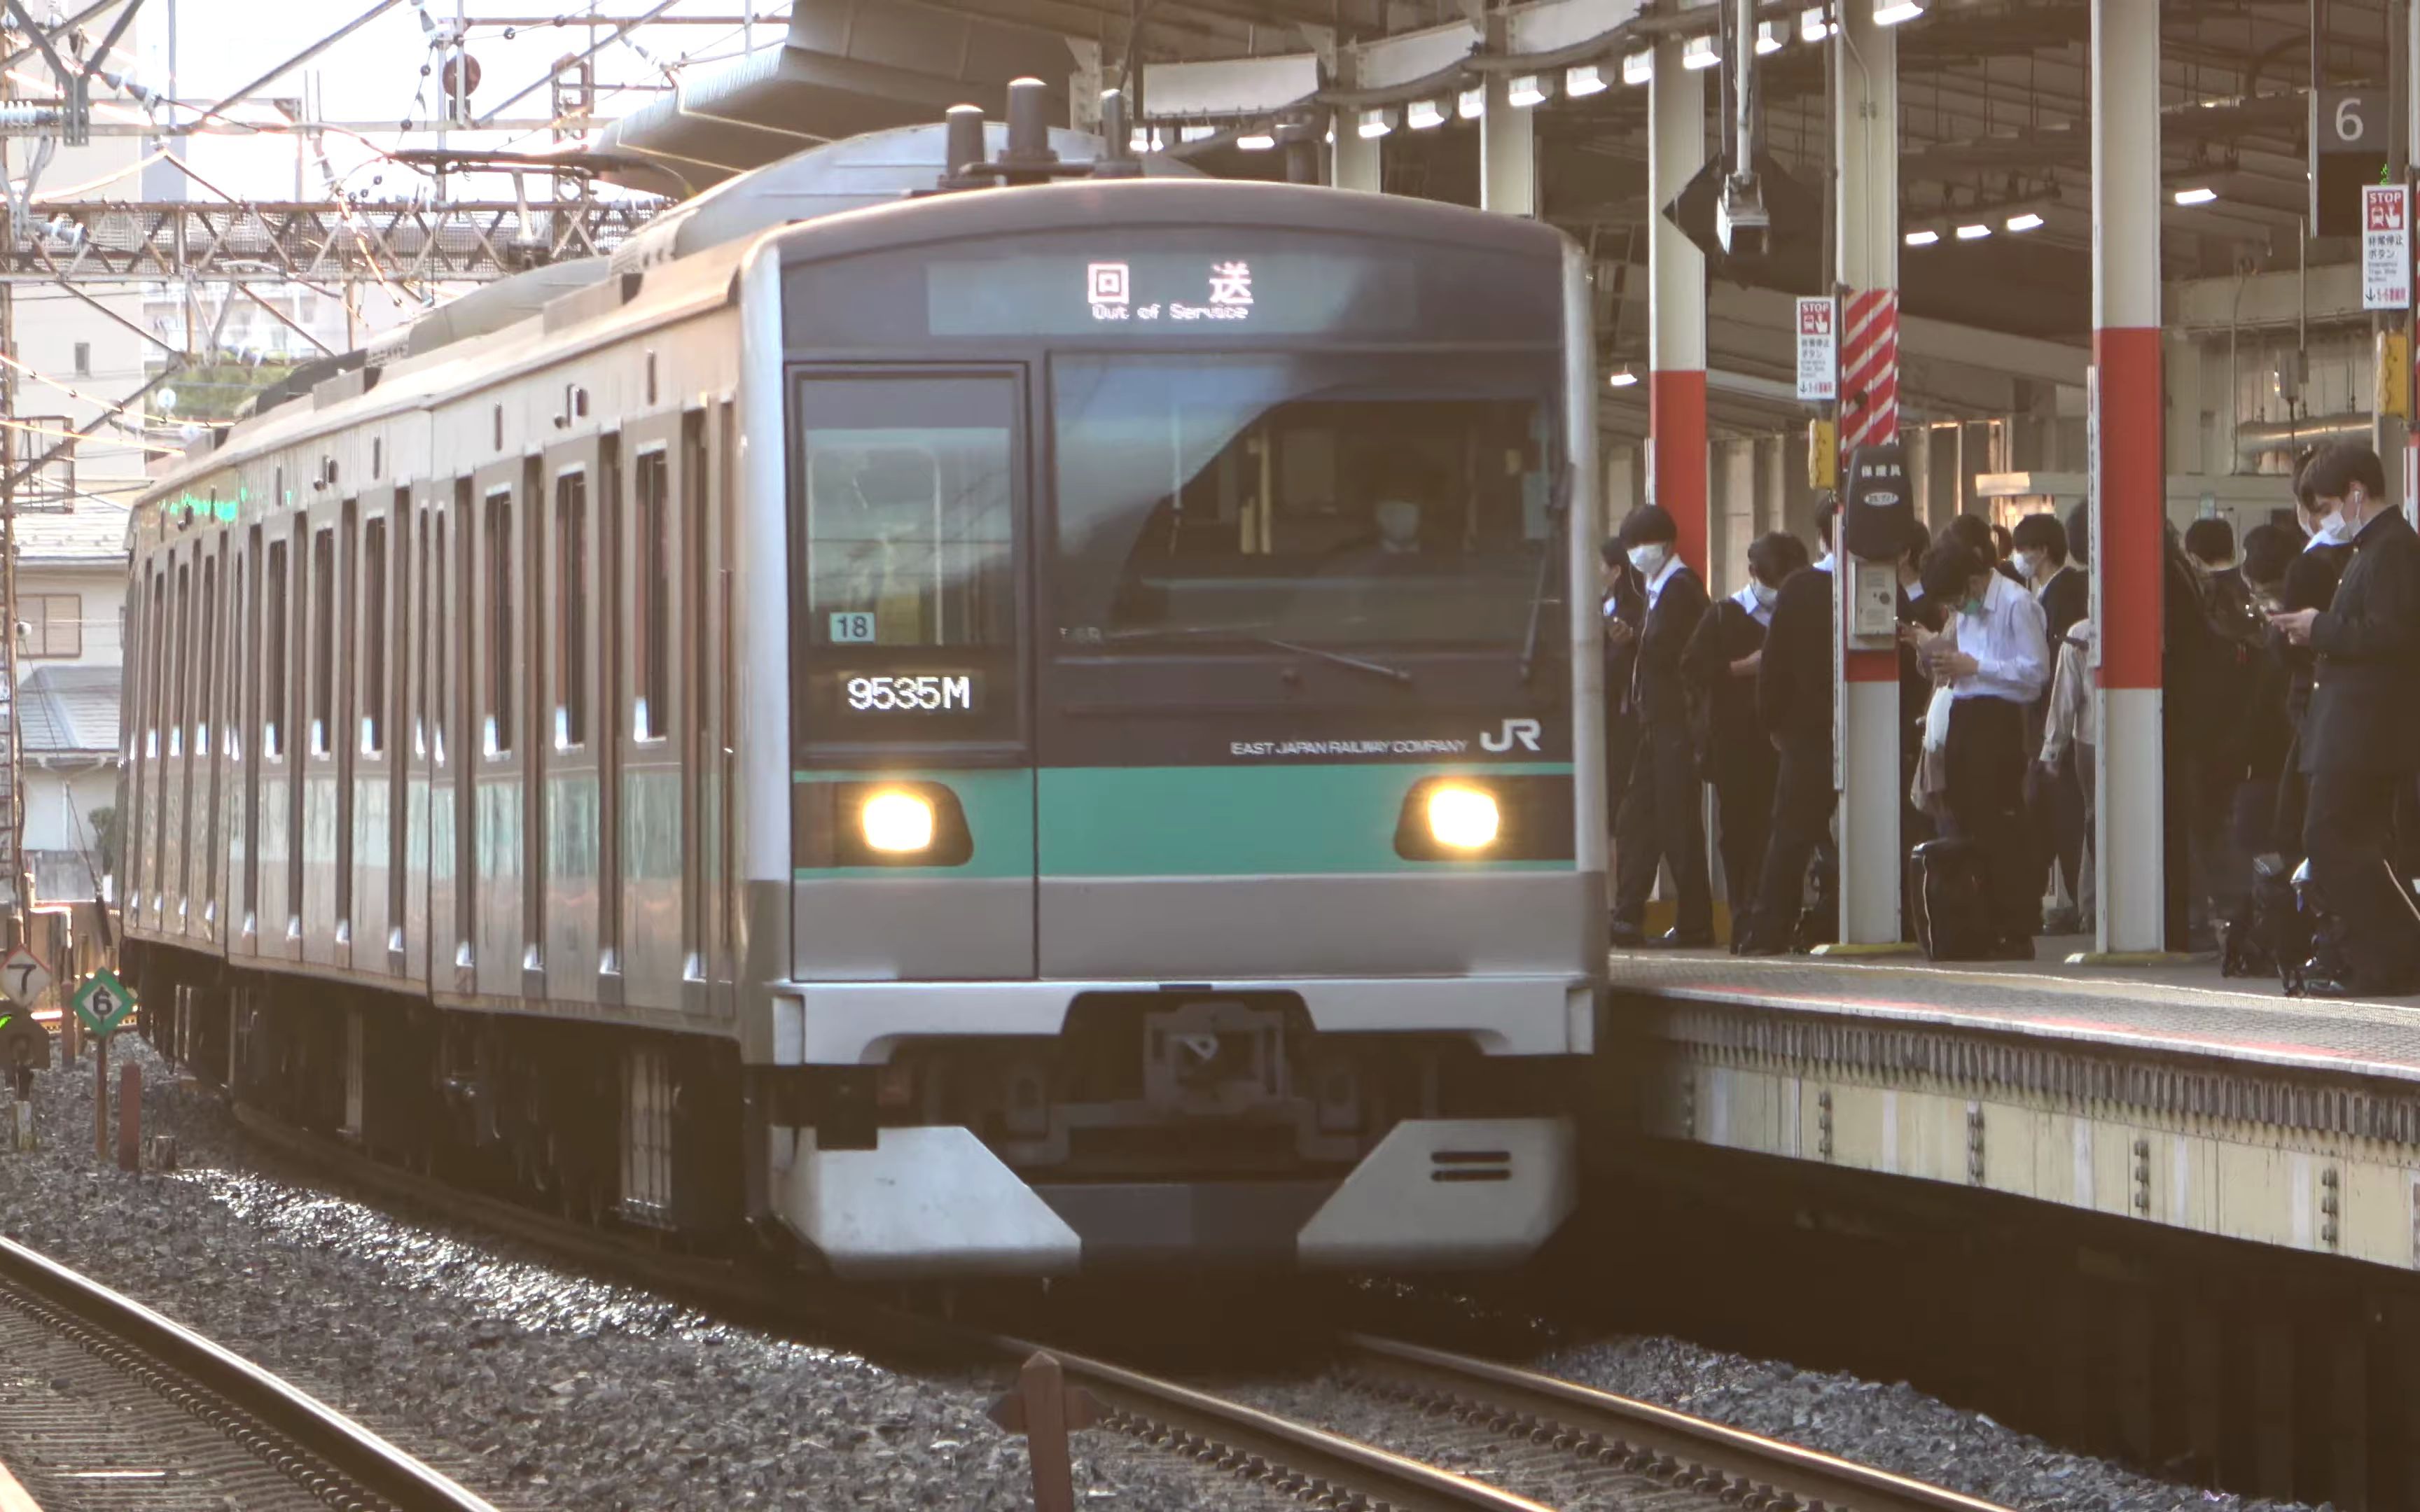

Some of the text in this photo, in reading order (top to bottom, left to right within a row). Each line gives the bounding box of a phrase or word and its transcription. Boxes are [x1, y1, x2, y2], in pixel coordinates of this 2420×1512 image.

[2336, 97, 2363, 141] 6
[2369, 192, 2401, 204] STOP
[1092, 303, 1249, 319] Out of Service
[1802, 303, 1829, 313] STOP
[837, 615, 868, 638] 18
[847, 676, 970, 710] 9535M
[1480, 718, 1541, 752] JR
[1230, 740, 1468, 755] EAST JAPAN RAILWAY COMPANY
[7, 964, 36, 995] 7
[92, 990, 113, 1016] 6
